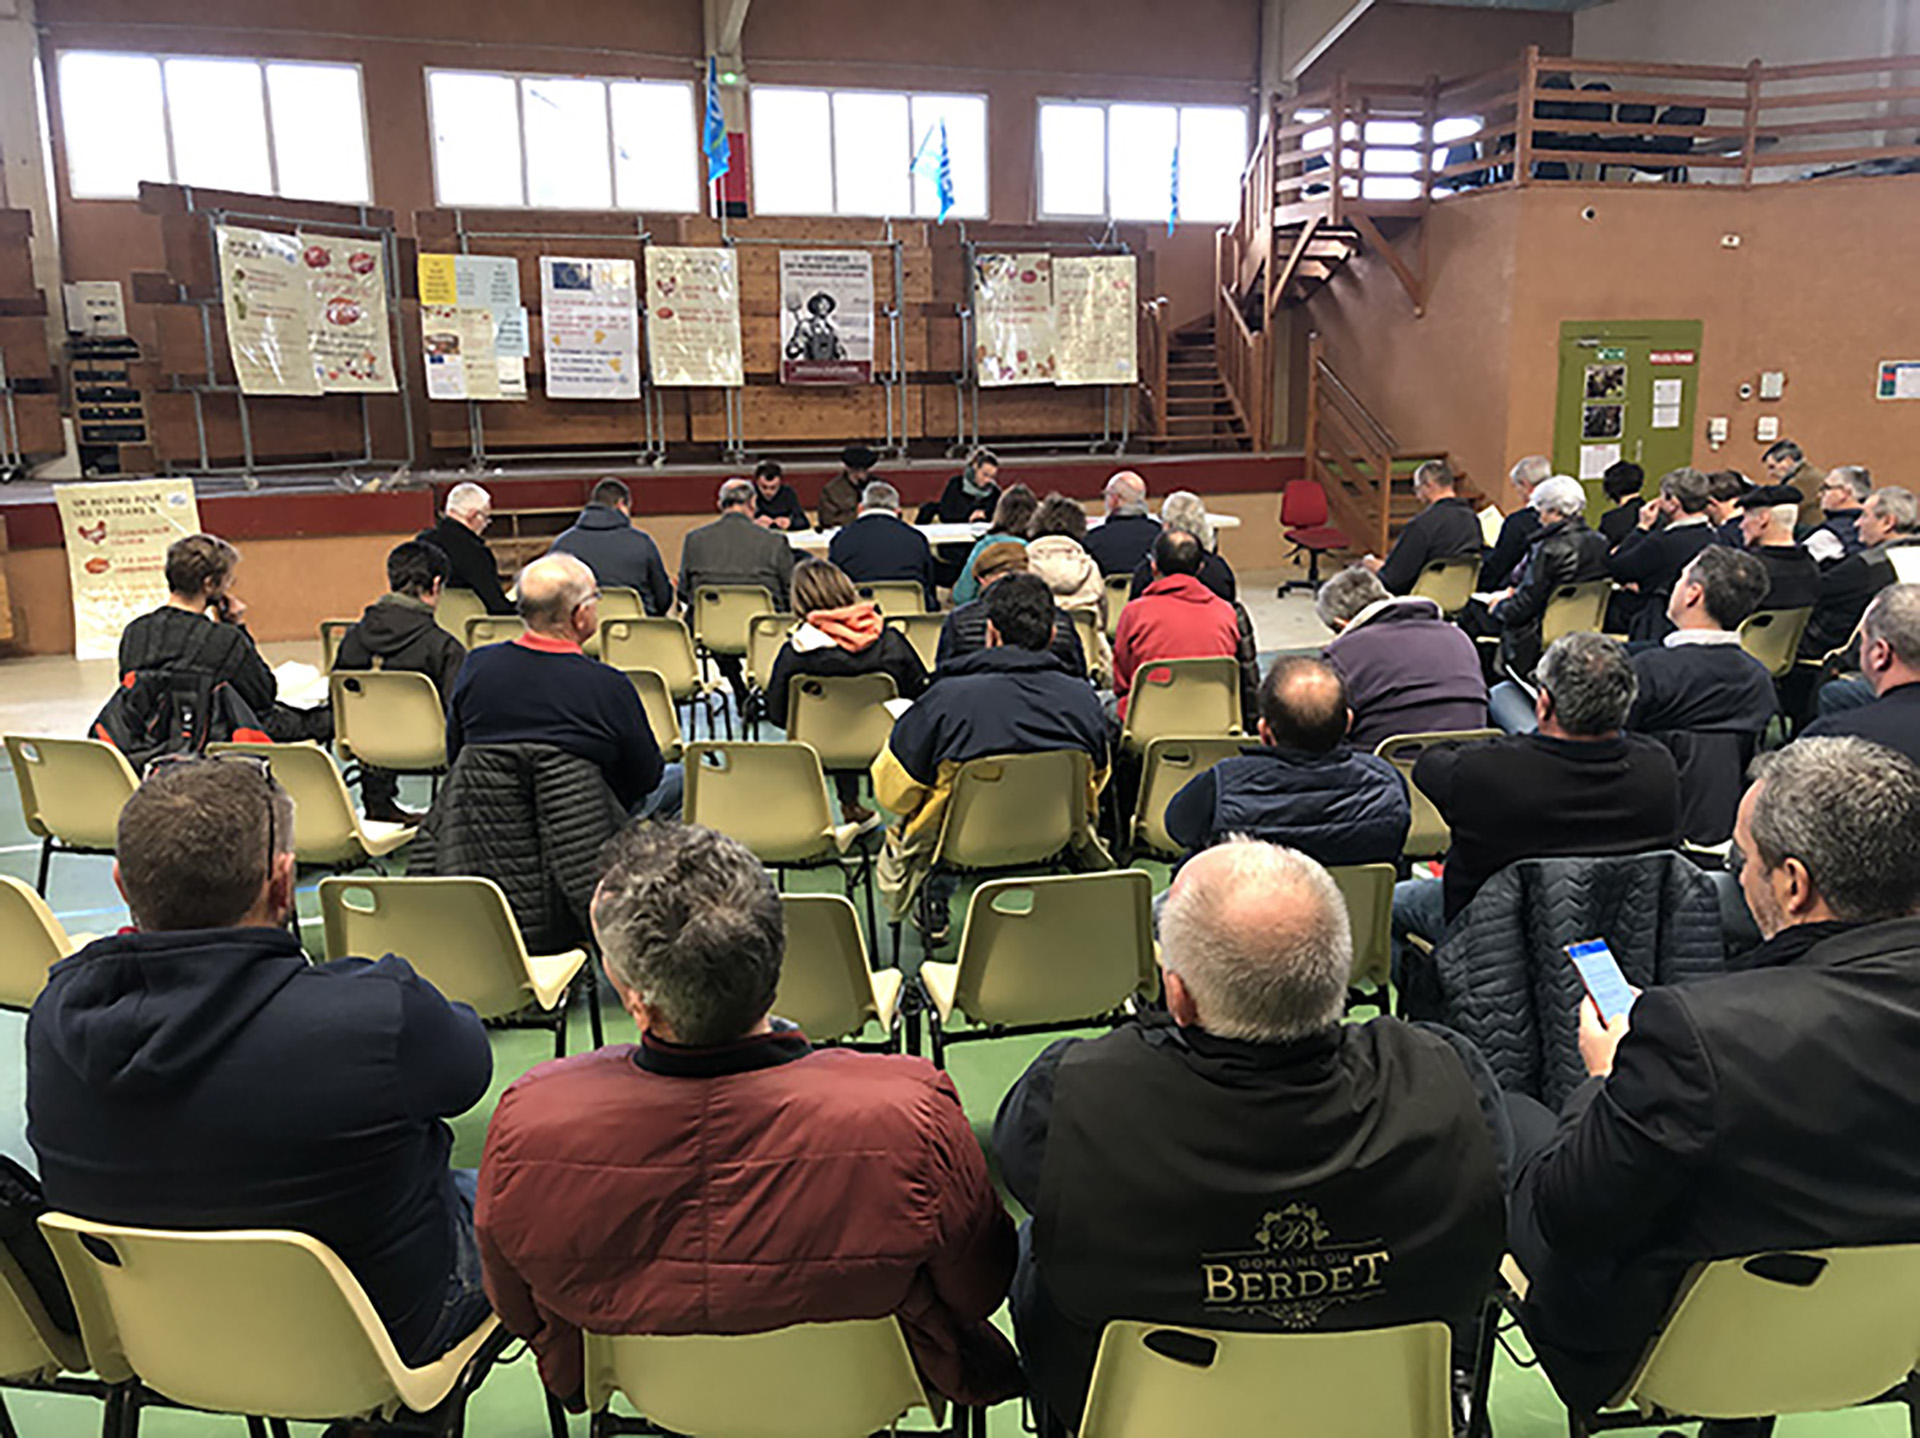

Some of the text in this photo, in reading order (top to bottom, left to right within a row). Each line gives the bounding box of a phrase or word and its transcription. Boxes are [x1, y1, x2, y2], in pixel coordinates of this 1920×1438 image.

[1201, 1250, 1390, 1303] BERDET
[1238, 1252, 1350, 1269] DOMAINE DU
